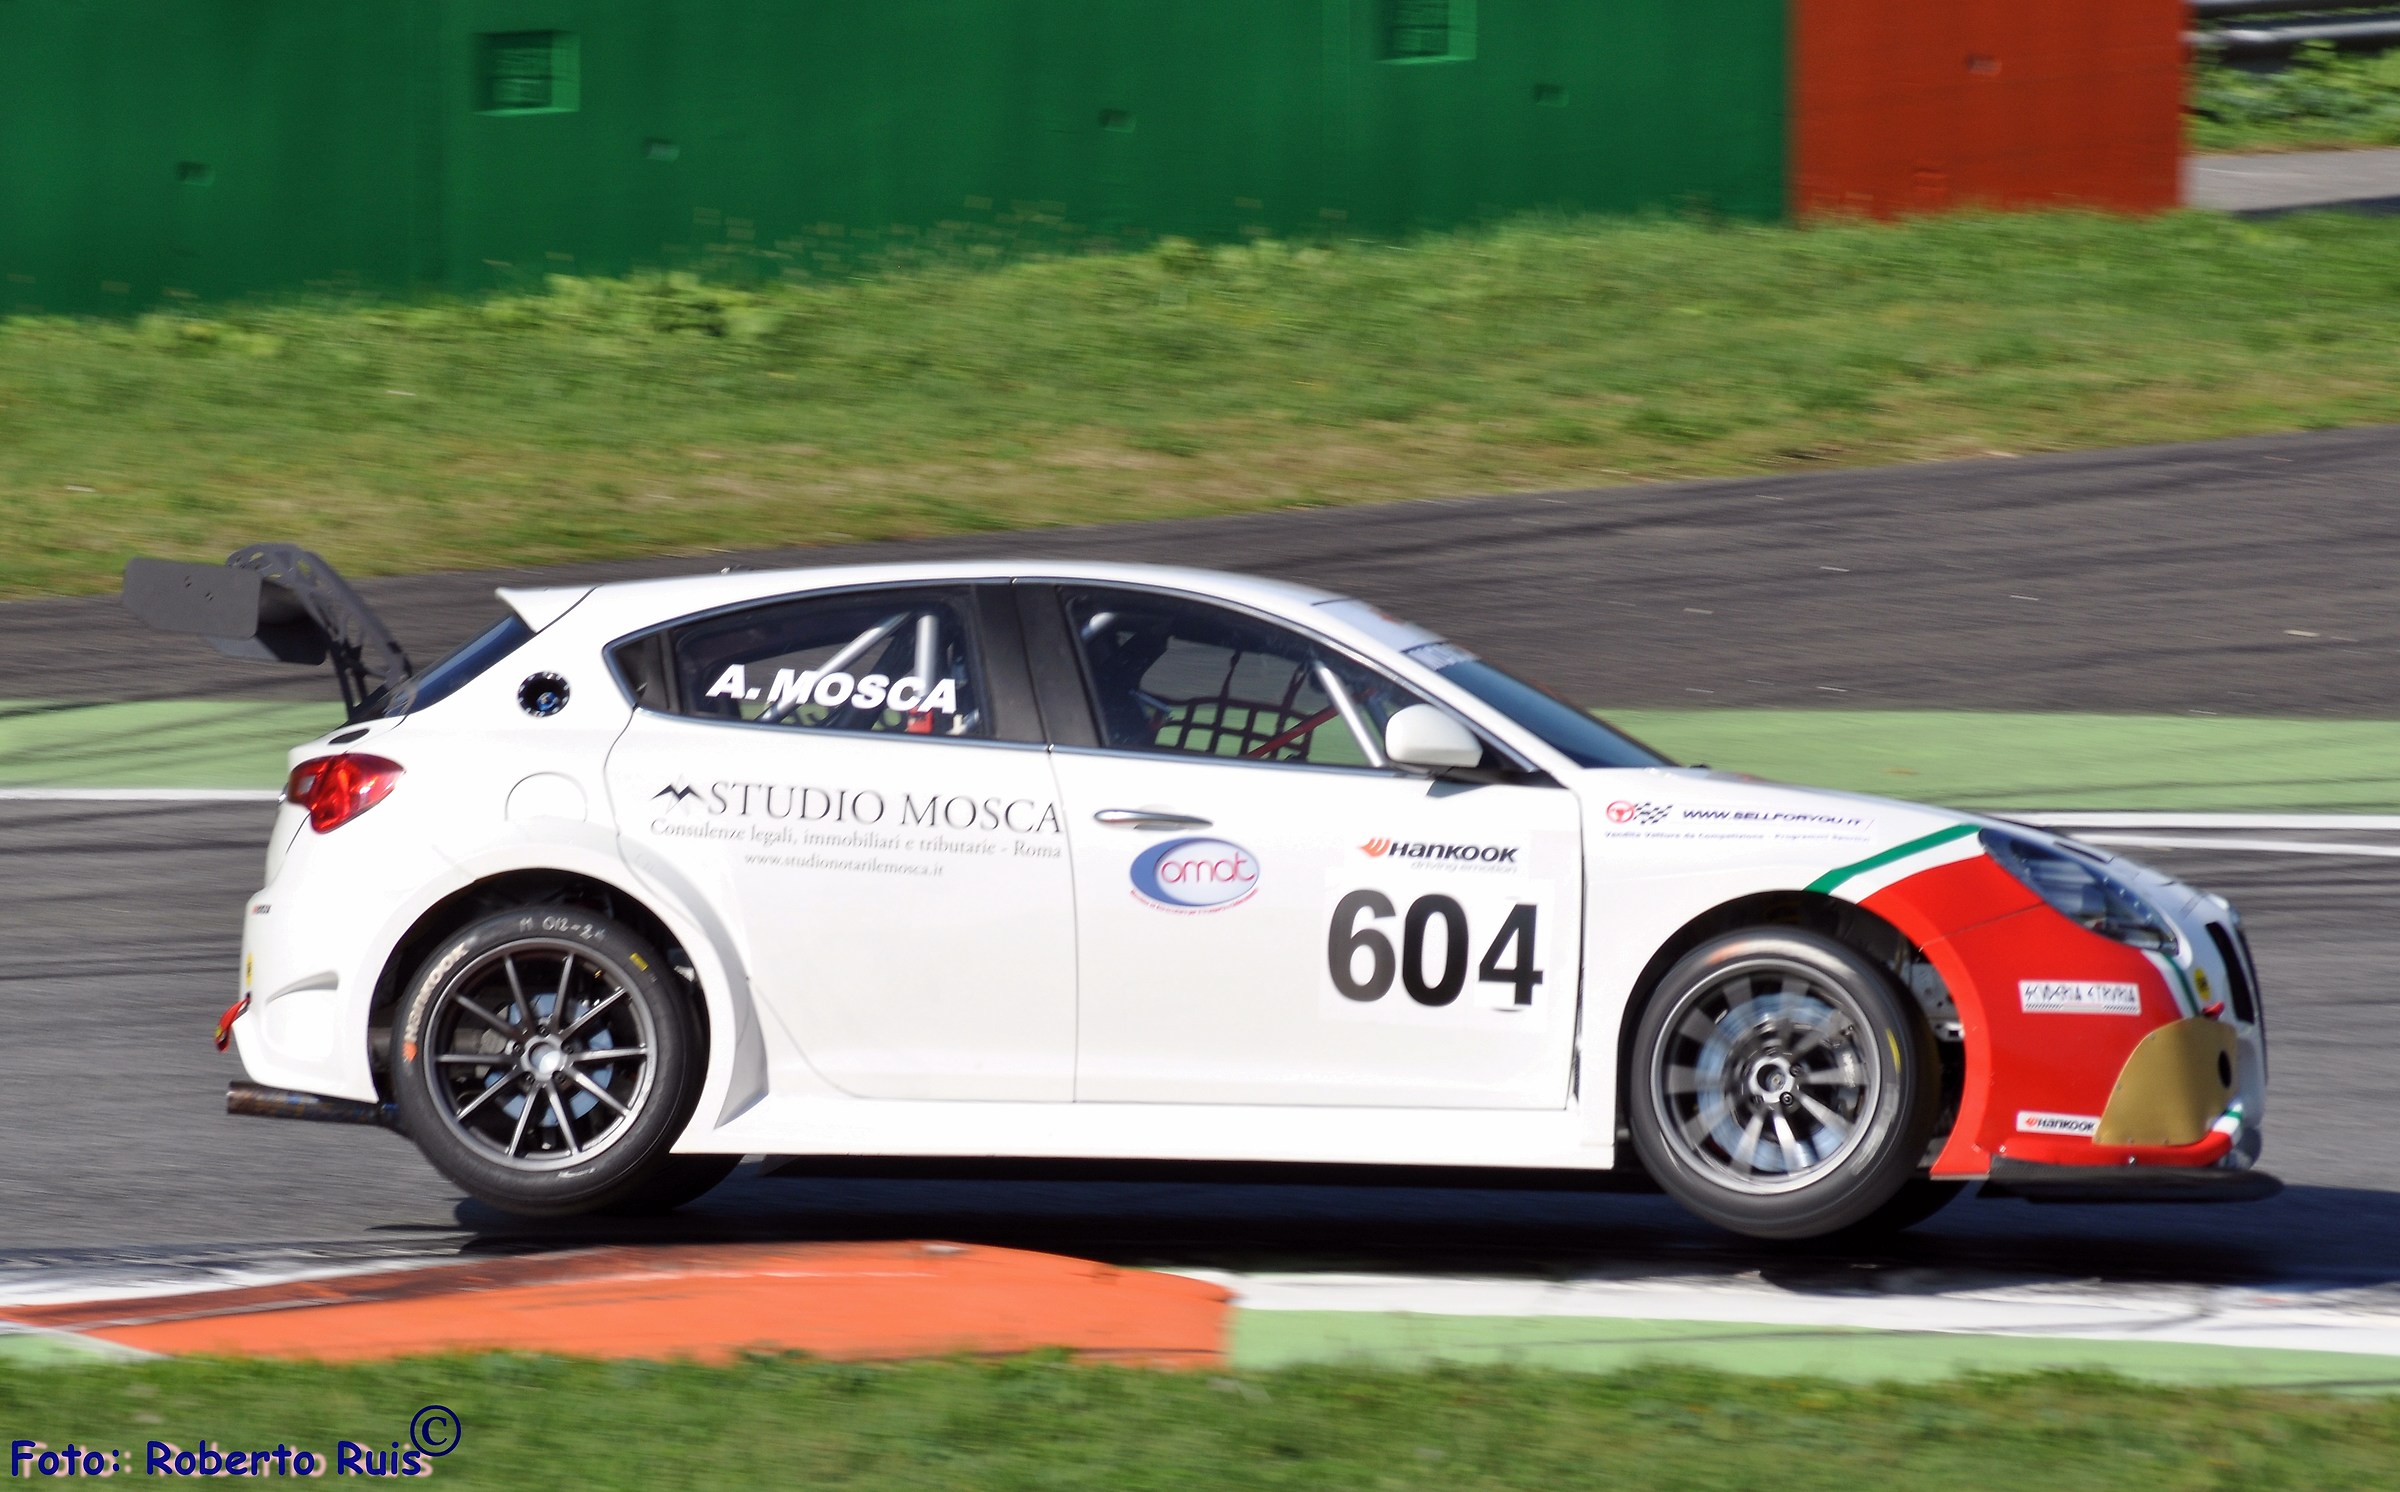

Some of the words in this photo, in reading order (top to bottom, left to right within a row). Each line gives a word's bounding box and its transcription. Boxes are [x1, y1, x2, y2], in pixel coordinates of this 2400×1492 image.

[705, 664, 761, 700] A.
[766, 668, 957, 714] MOSCA
[707, 782, 884, 825] STUDIO
[901, 794, 1062, 833] MOSCA
[651, 818, 746, 840] Consulenze
[751, 824, 798, 846] legali,
[803, 829, 901, 850] immobiliari
[905, 839, 915, 850] e
[920, 836, 996, 855] tributarie
[1013, 840, 1062, 858] Roma
[744, 853, 944, 877] www.studionotarilemosca.it
[1328, 889, 1544, 1007] 604
